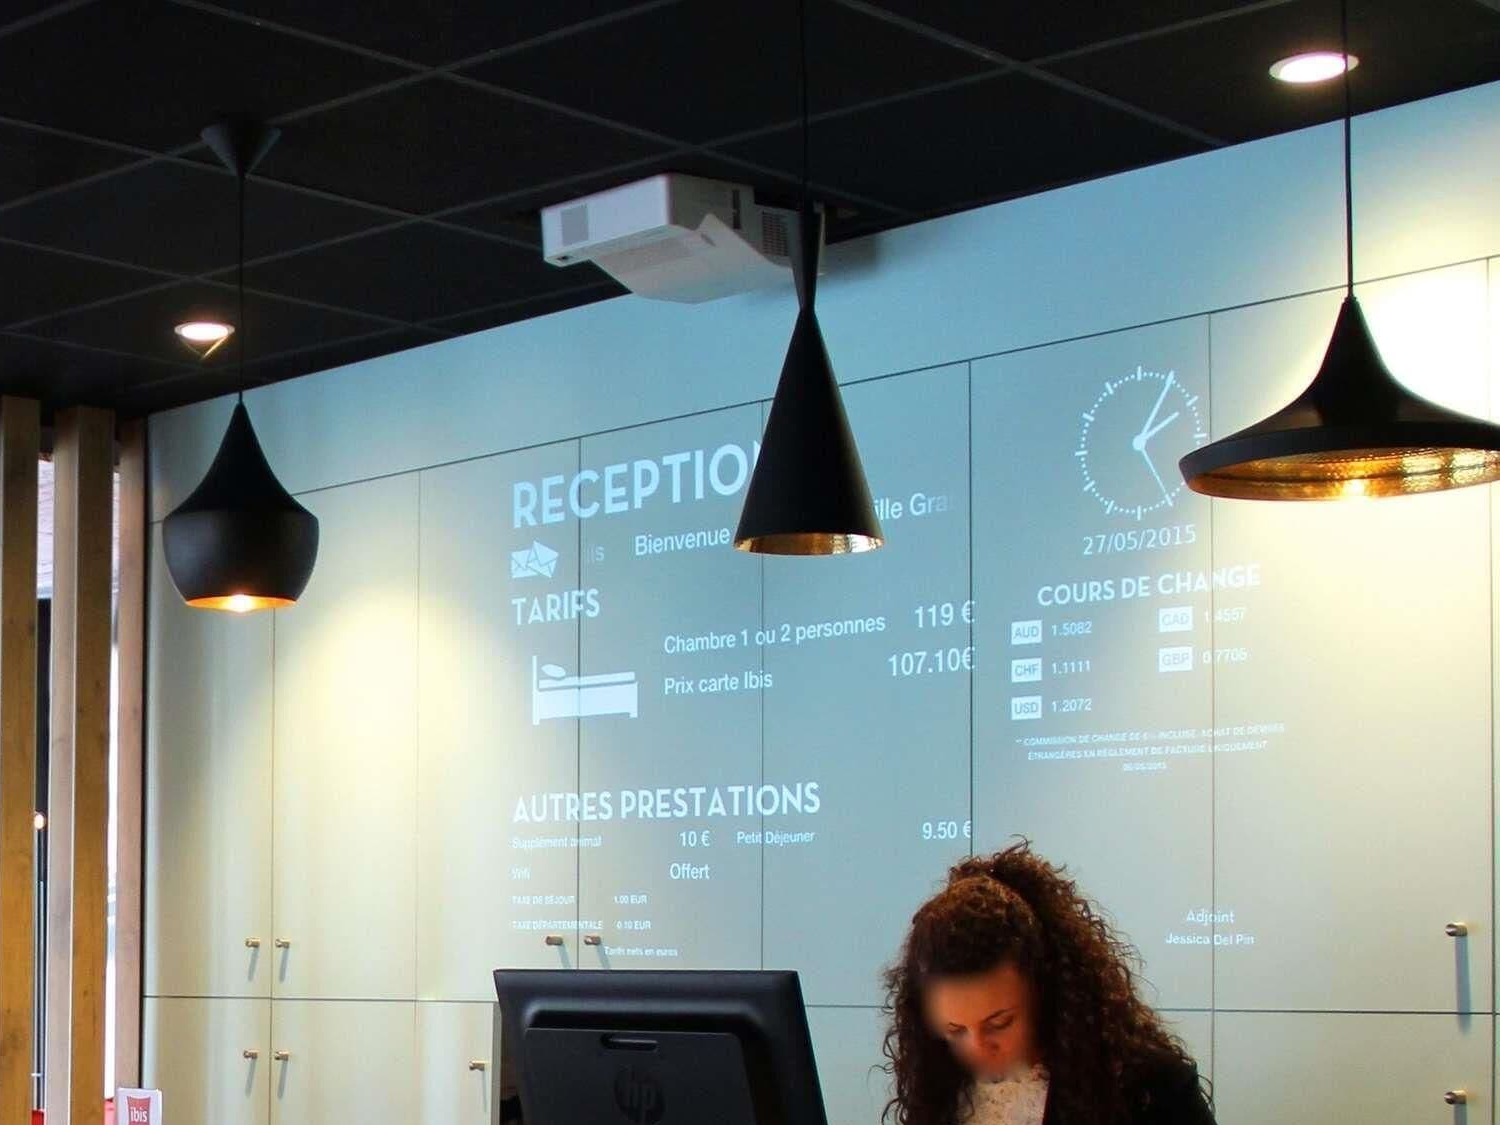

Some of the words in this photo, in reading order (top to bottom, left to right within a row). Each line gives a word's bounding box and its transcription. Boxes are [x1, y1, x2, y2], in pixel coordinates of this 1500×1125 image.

[513, 439, 762, 529] RECEPTIO
[635, 527, 731, 556] Bienvenue
[873, 496, 903, 521] ille
[1083, 524, 1196, 556] 27/05/2015
[1037, 579, 1115, 607] COURS
[1121, 575, 1151, 599] DE
[1157, 564, 1261, 595] CHANGE
[511, 588, 600, 626] TARIFS
[664, 631, 737, 654] Chambre
[740, 629, 748, 646] 1
[754, 629, 776, 646] ou
[780, 623, 791, 643] 2
[795, 616, 886, 644] personnes
[914, 602, 954, 629] 119
[961, 600, 976, 624] €
[1013, 624, 1041, 642] AUD
[888, 646, 976, 677] 107.10€
[1013, 661, 1041, 678] CHF
[664, 677, 694, 695] Prix
[698, 673, 740, 693] carte
[744, 670, 773, 689] Ibis
[1013, 698, 1041, 716] USD
[1051, 697, 1092, 713] 1.2072
[514, 790, 613, 822] AUTRES
[620, 781, 821, 819] PRESTATIONS
[679, 830, 698, 847] 10
[700, 830, 710, 847] €
[736, 832, 762, 844] Petit
[922, 821, 958, 840] 9.50
[669, 862, 710, 880] Offert
[1186, 908, 1235, 927] Adjoint
[1165, 933, 1211, 945] Jessica
[1213, 933, 1233, 946] Del
[130, 1106, 149, 1124] ibis
